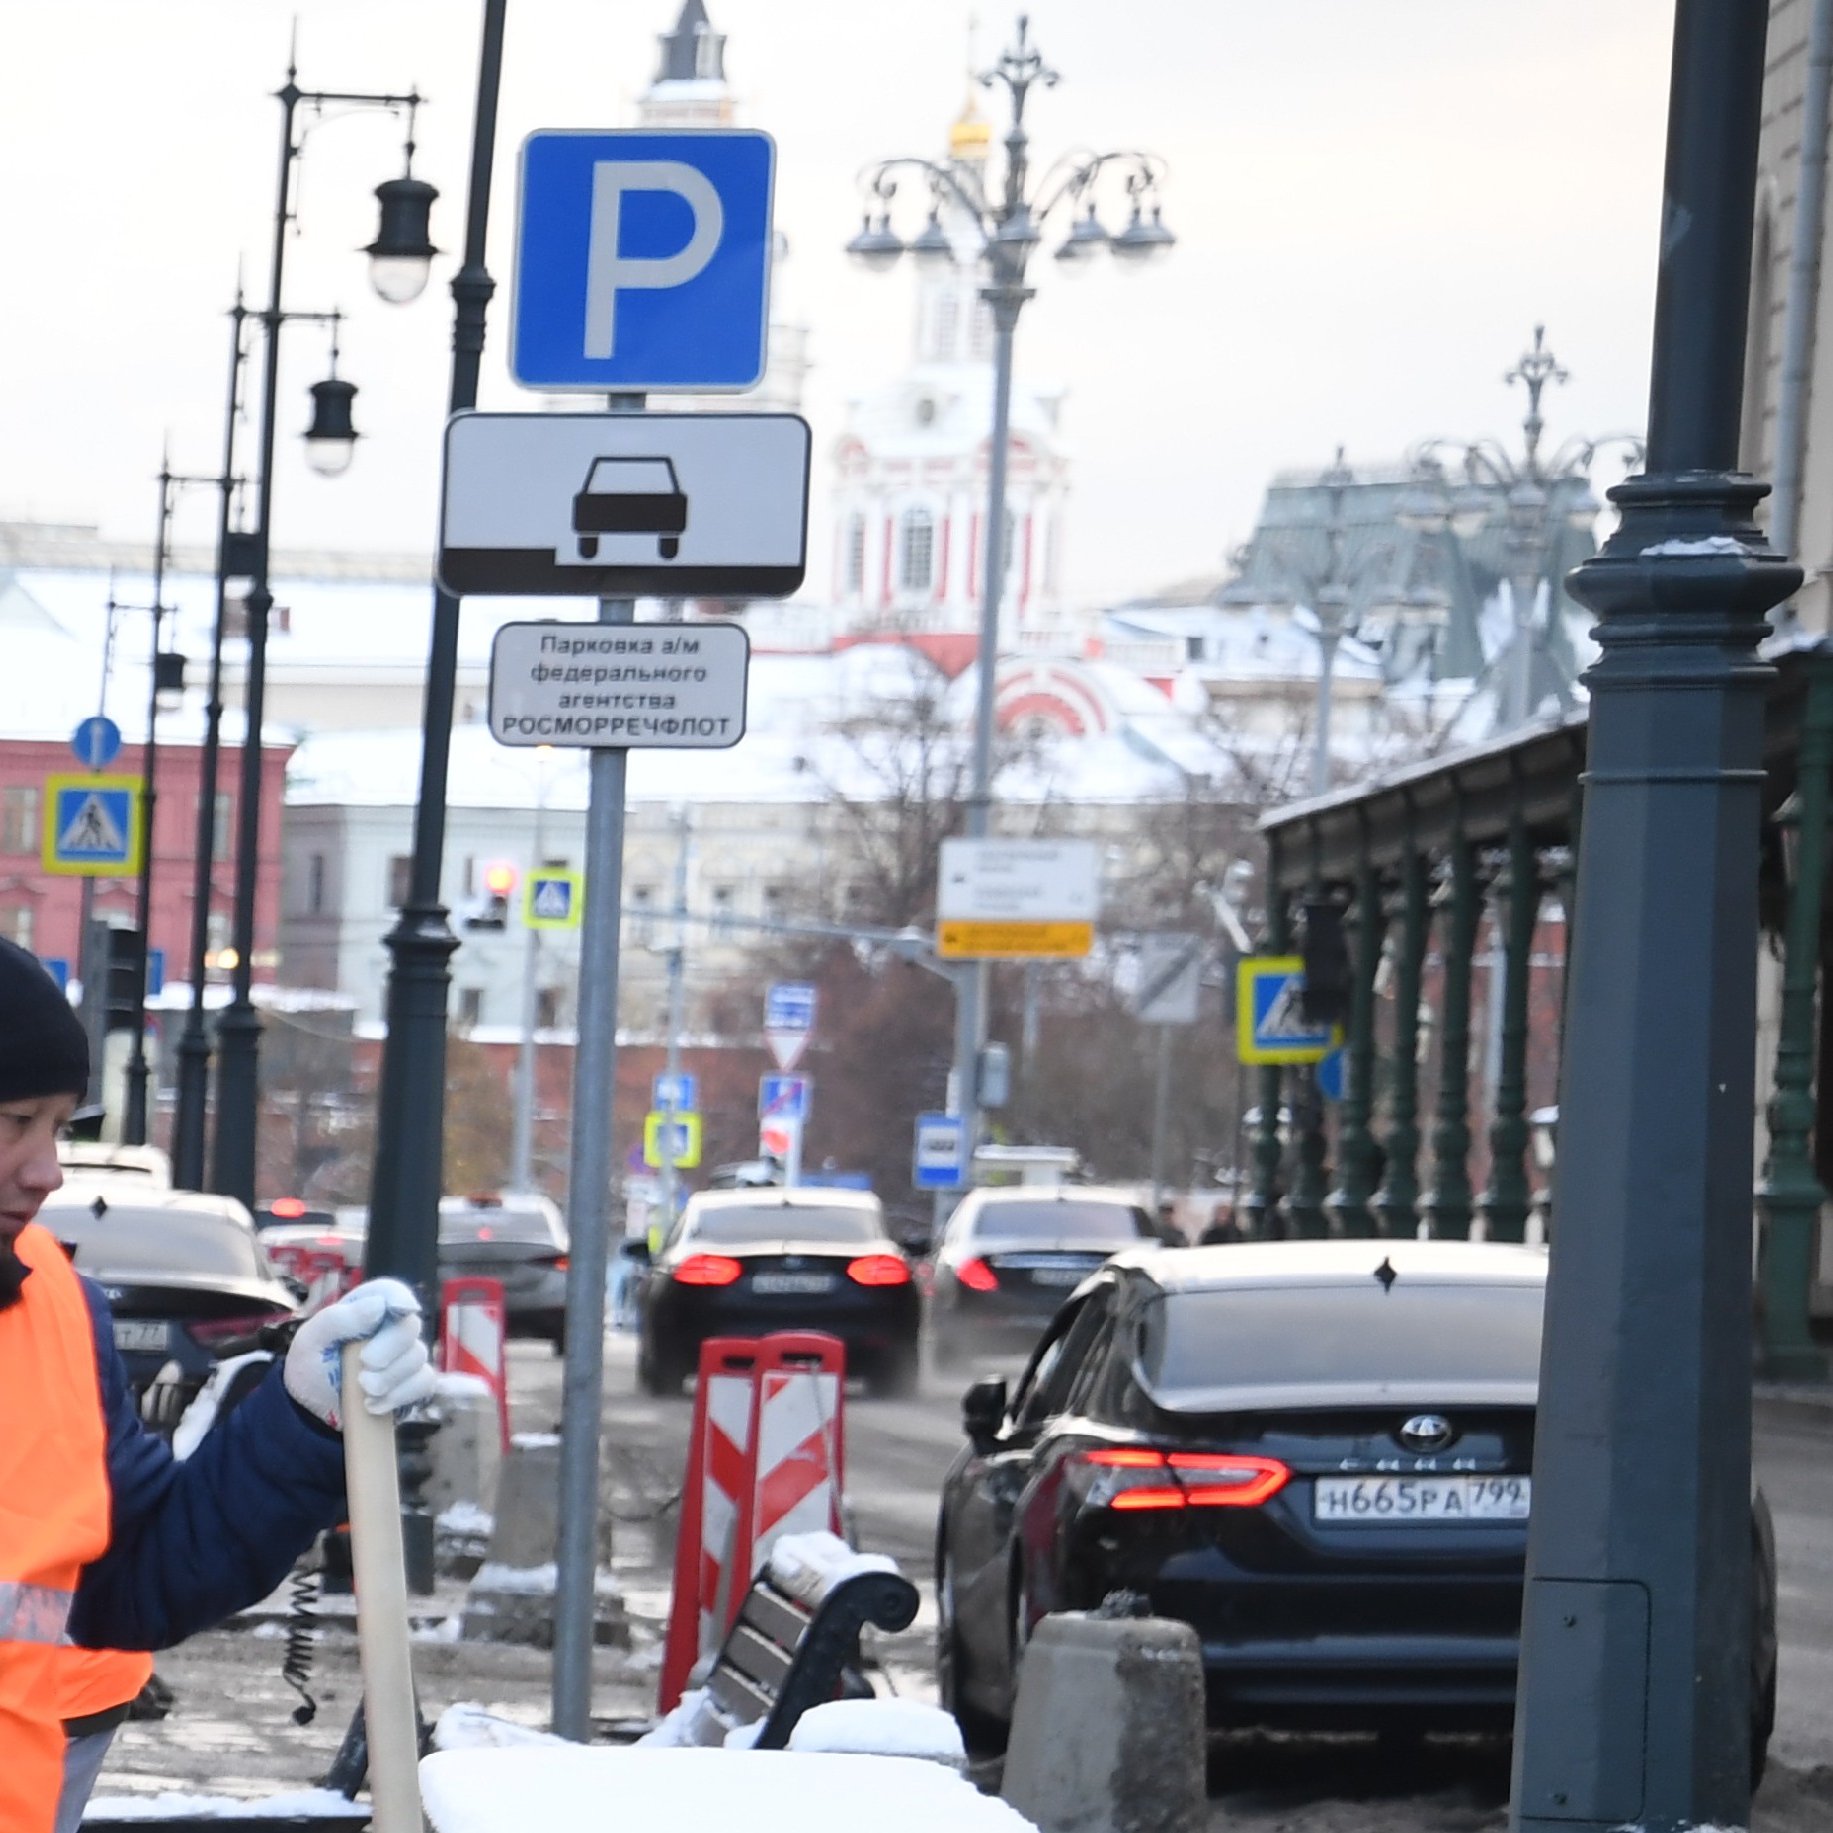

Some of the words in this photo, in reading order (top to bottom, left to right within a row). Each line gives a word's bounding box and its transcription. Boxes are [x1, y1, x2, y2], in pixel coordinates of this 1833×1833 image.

[583, 159, 724, 359] P
[540, 635, 654, 657] Парковка
[661, 635, 700, 655] а/м
[531, 662, 707, 685] федерального
[558, 693, 676, 710] агентства
[502, 716, 730, 736] РОСМОРРЕЧФЛОТ
